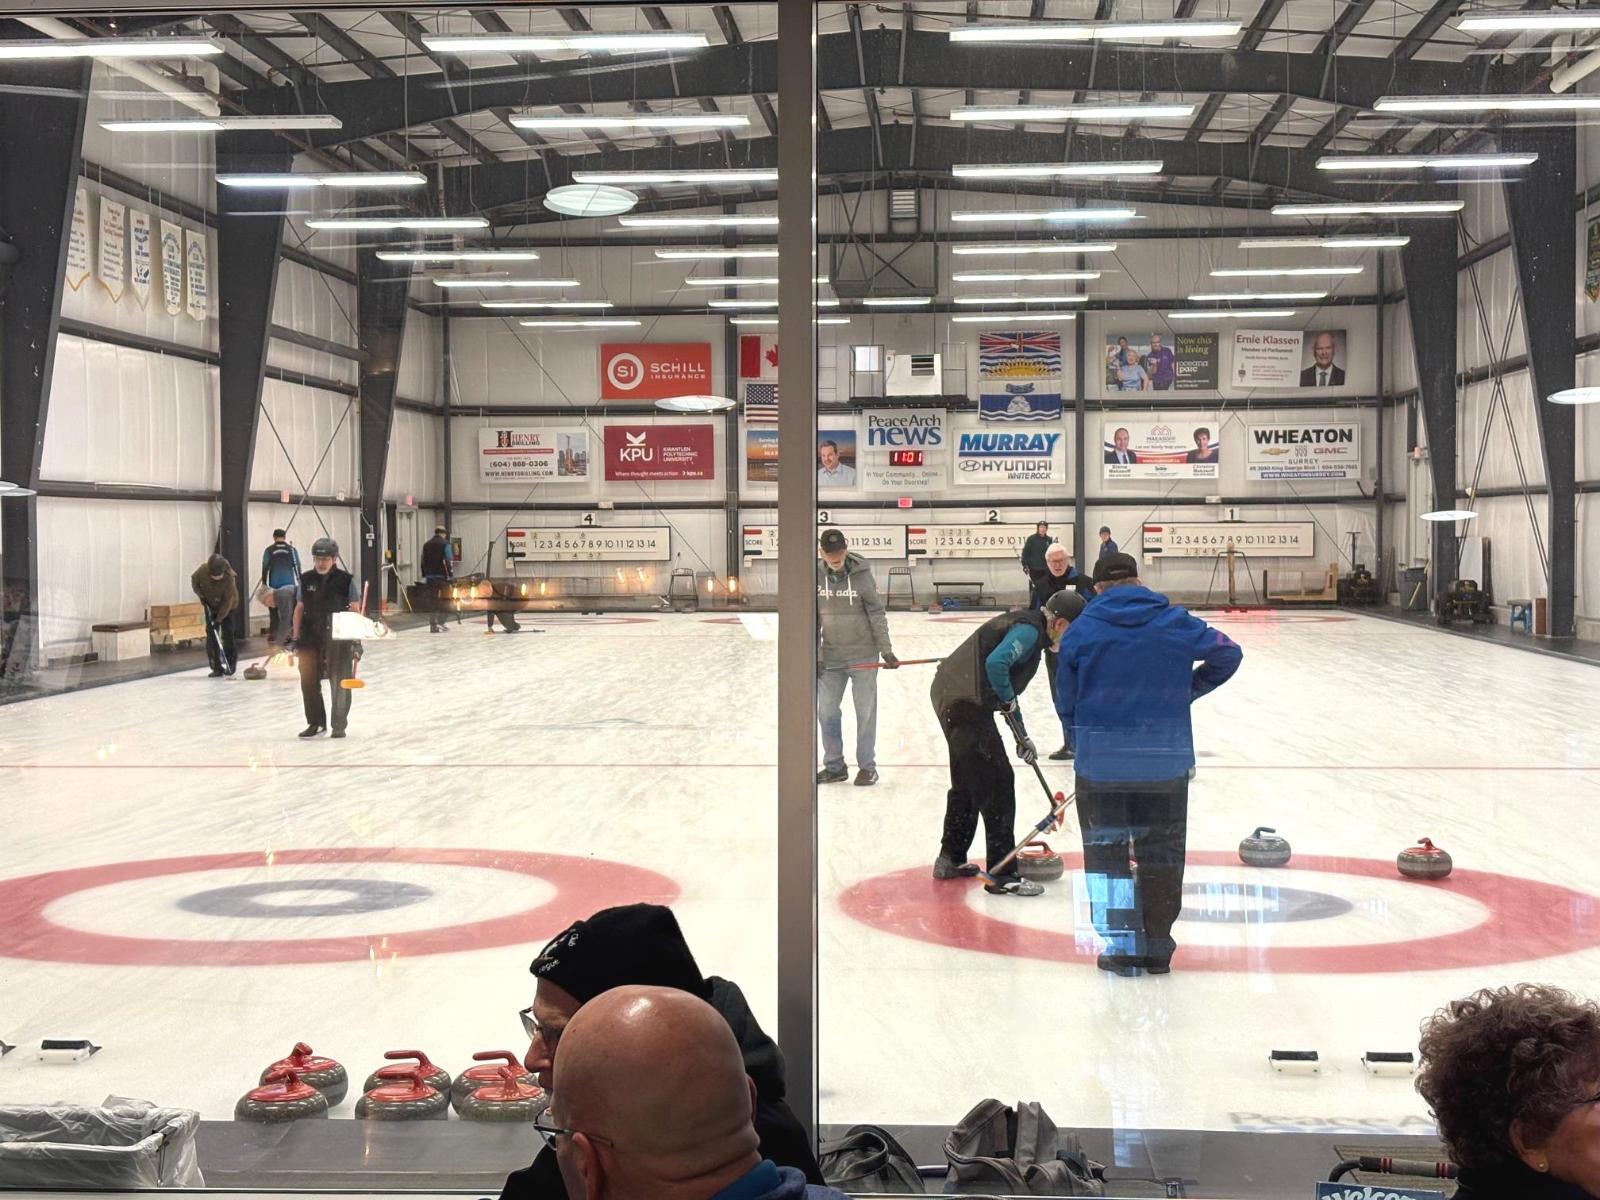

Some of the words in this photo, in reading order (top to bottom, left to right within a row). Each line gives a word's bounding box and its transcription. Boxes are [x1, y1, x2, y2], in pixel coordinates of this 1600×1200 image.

[1177, 336, 1195, 345] Now
[1197, 335, 1212, 345] this
[1236, 334, 1260, 343] Ernie
[1263, 335, 1300, 345] Klassen
[1185, 344, 1209, 355] living
[617, 365, 634, 378] SI
[650, 362, 706, 373] SCHILL
[1180, 366, 1198, 374] parc
[868, 415, 907, 427] Peace
[909, 414, 942, 427] Arch
[512, 433, 541, 441] HENRY
[868, 426, 942, 446] news
[1253, 428, 1353, 444] WHEATON
[959, 432, 1062, 453] MURRAY
[620, 447, 653, 461] KPU
[894, 452, 922, 463] 11:01
[489, 460, 511, 468] (604)
[982, 460, 1052, 471] HYUNDAI
[1007, 472, 1030, 480] WHITE
[1030, 472, 1052, 480] ROCK
[583, 513, 593, 525] 4
[819, 511, 829, 523] 3
[988, 509, 998, 522] 2
[1229, 508, 1234, 520] 1
[539, 540, 545, 549] 2
[547, 540, 553, 549] 3
[555, 540, 561, 549] 4
[564, 540, 570, 549] 5
[572, 540, 579, 549] 6
[581, 540, 586, 549] 7
[588, 540, 594, 549] 8
[597, 540, 602, 549] 9
[605, 539, 614, 548] 10
[616, 539, 624, 548] 11
[626, 539, 634, 548] 12
[637, 539, 645, 548] 13
[647, 539, 656, 548] 14
[852, 537, 859, 546] 11
[861, 537, 870, 546] 12
[872, 537, 881, 546] 13
[883, 537, 892, 546] 14
[940, 537, 946, 546] 2
[948, 537, 954, 546] 3
[957, 537, 963, 546] 4
[966, 537, 972, 546] 5
[974, 537, 980, 546] 6
[983, 537, 988, 546] 7
[990, 537, 996, 546] 8
[998, 537, 1004, 546] 9
[1007, 537, 1016, 546] 10
[1176, 535, 1182, 545] 2
[1185, 535, 1191, 545] 3
[1193, 535, 1200, 545] 4
[1202, 535, 1208, 545] 5
[1210, 535, 1217, 545] 6
[1220, 535, 1225, 545] 7
[1236, 535, 1242, 544] 9
[1245, 535, 1254, 544] 10
[1257, 535, 1265, 544] 11
[1267, 535, 1276, 544] 12
[1279, 535, 1287, 544] 13
[1290, 535, 1299, 544] 14
